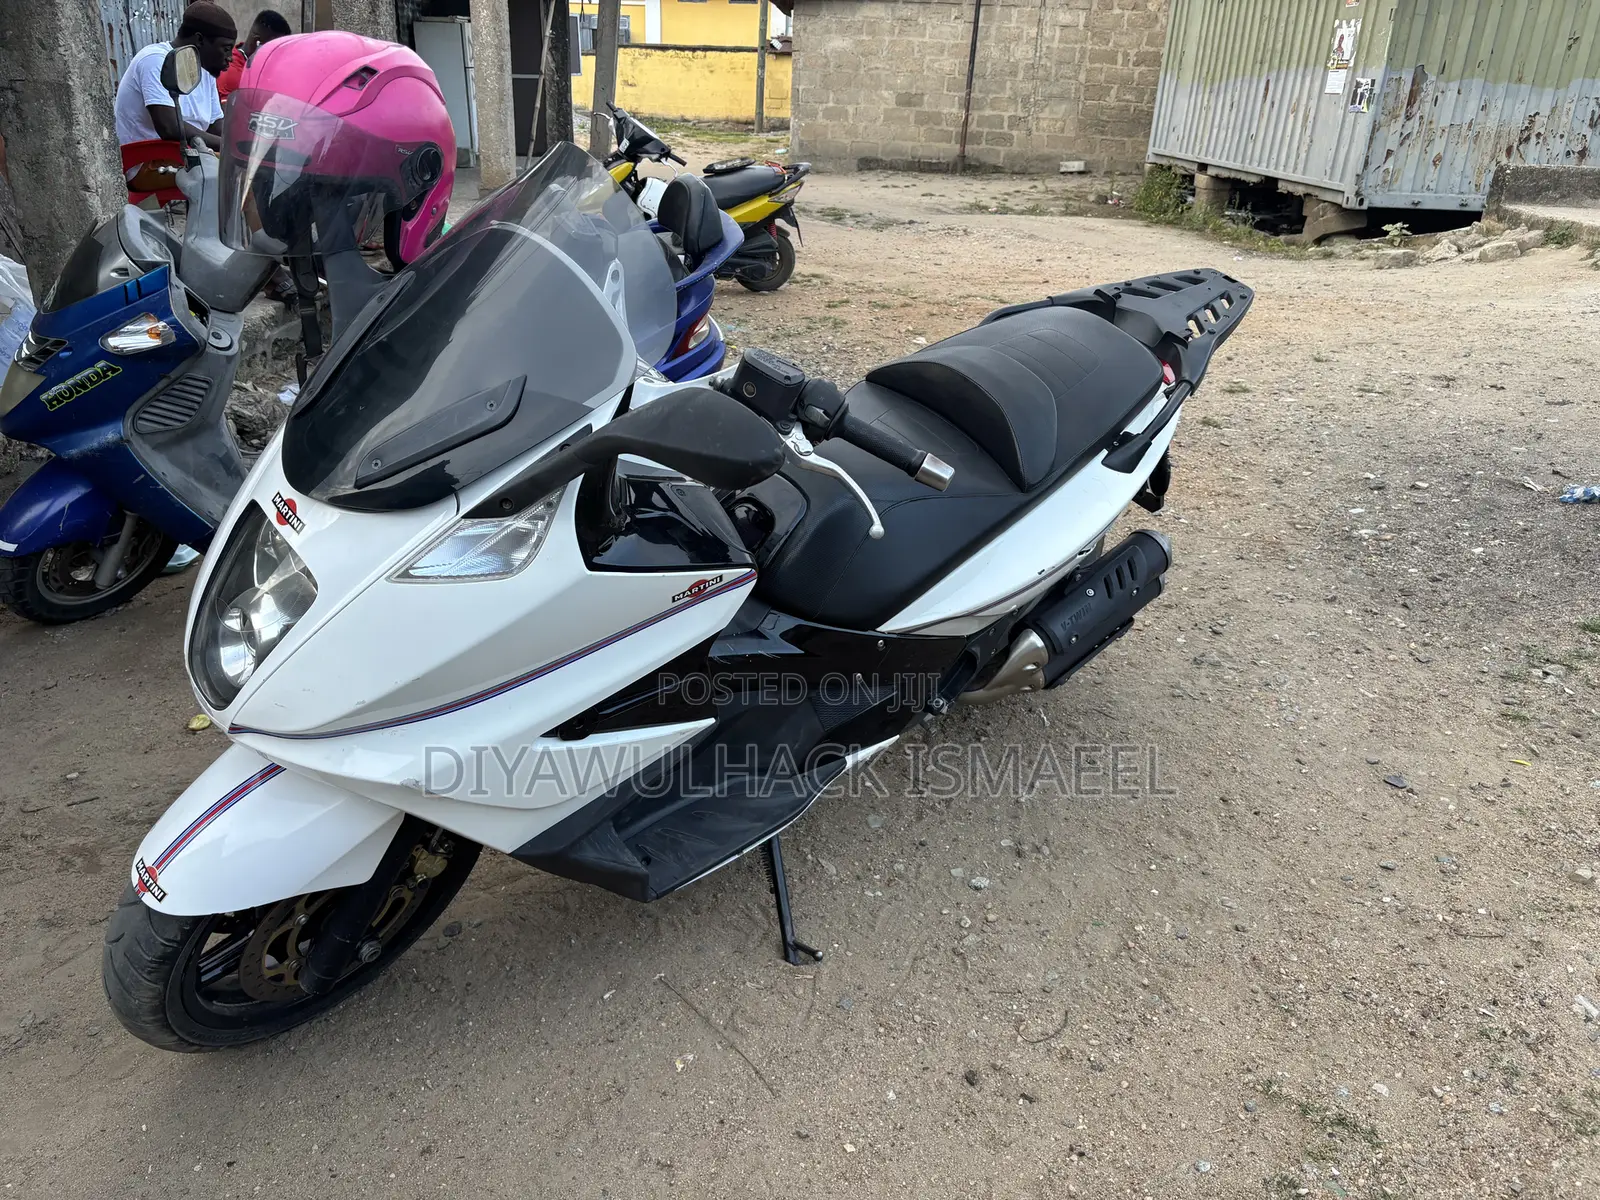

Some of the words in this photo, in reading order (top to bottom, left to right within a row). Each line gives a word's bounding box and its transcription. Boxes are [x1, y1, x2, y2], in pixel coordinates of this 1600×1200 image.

[40, 359, 123, 412] HONDA
[273, 493, 303, 531] MARTINI
[674, 576, 720, 601] MARTINI
[1060, 602, 1093, 632] V-TWIN
[136, 860, 165, 899] MARTINI
